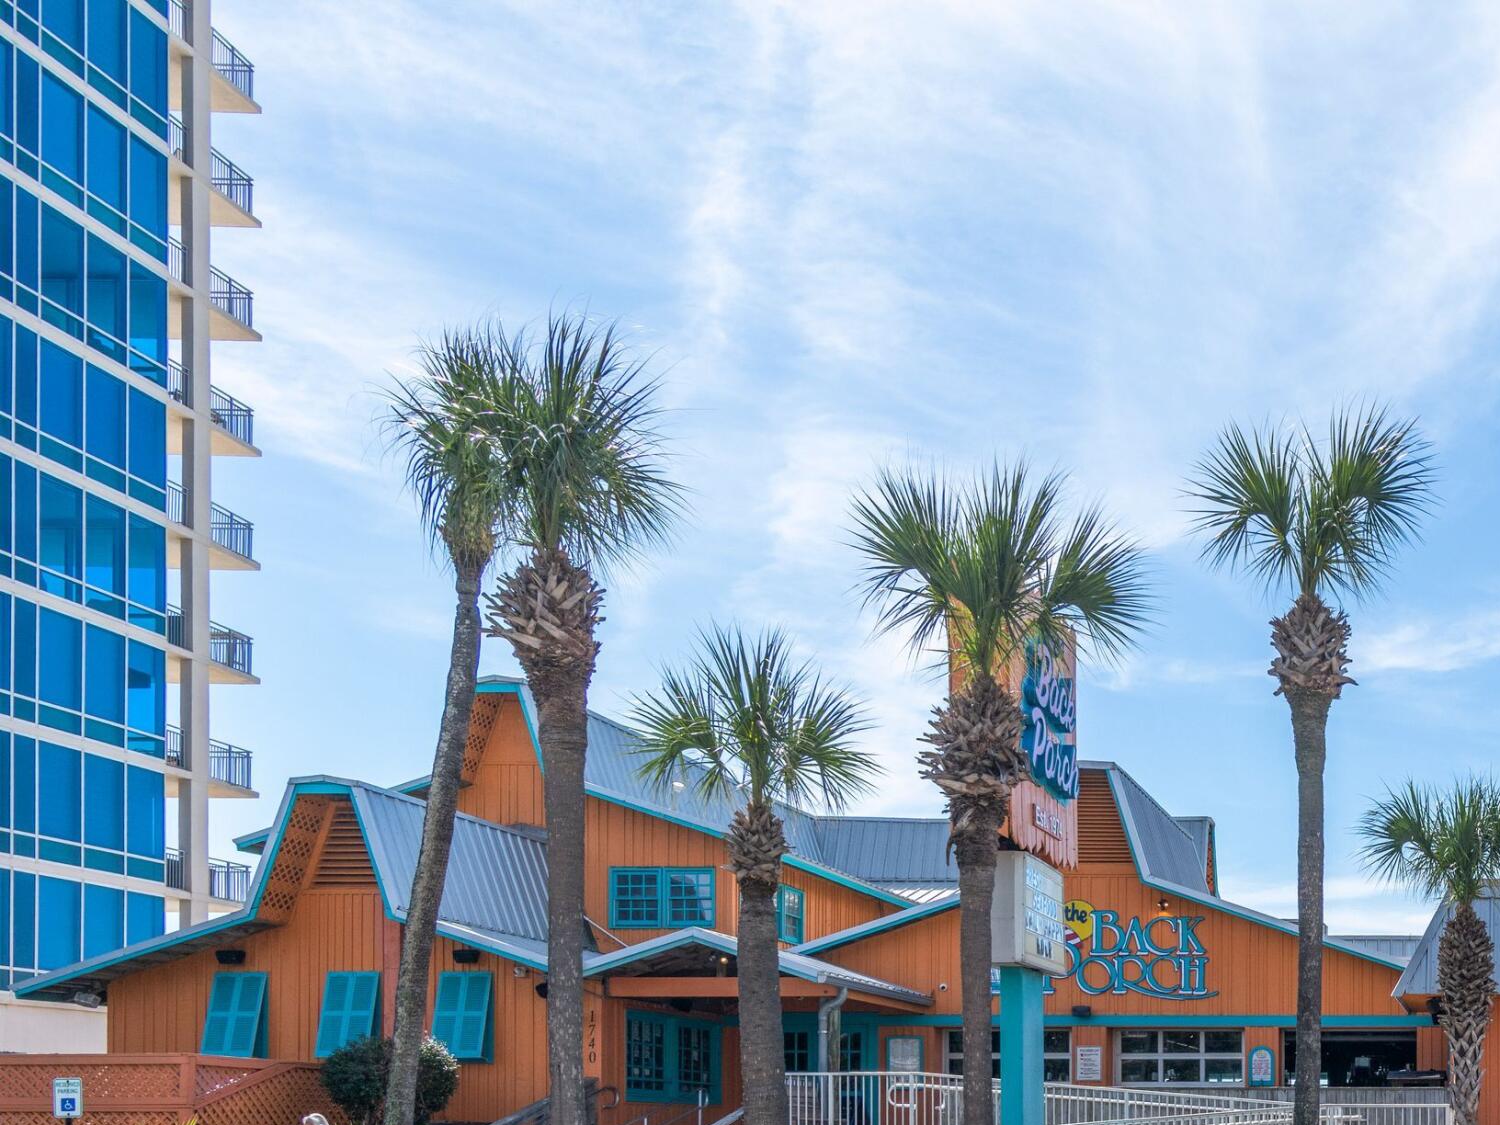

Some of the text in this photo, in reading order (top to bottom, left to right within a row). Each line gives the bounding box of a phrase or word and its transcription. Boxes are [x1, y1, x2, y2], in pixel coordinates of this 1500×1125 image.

[1036, 643, 1076, 733] Back
[1031, 707, 1079, 799] Porch
[1064, 902, 1088, 923] the
[1090, 910, 1206, 956] BACK
[588, 1010, 597, 1064] 1740
